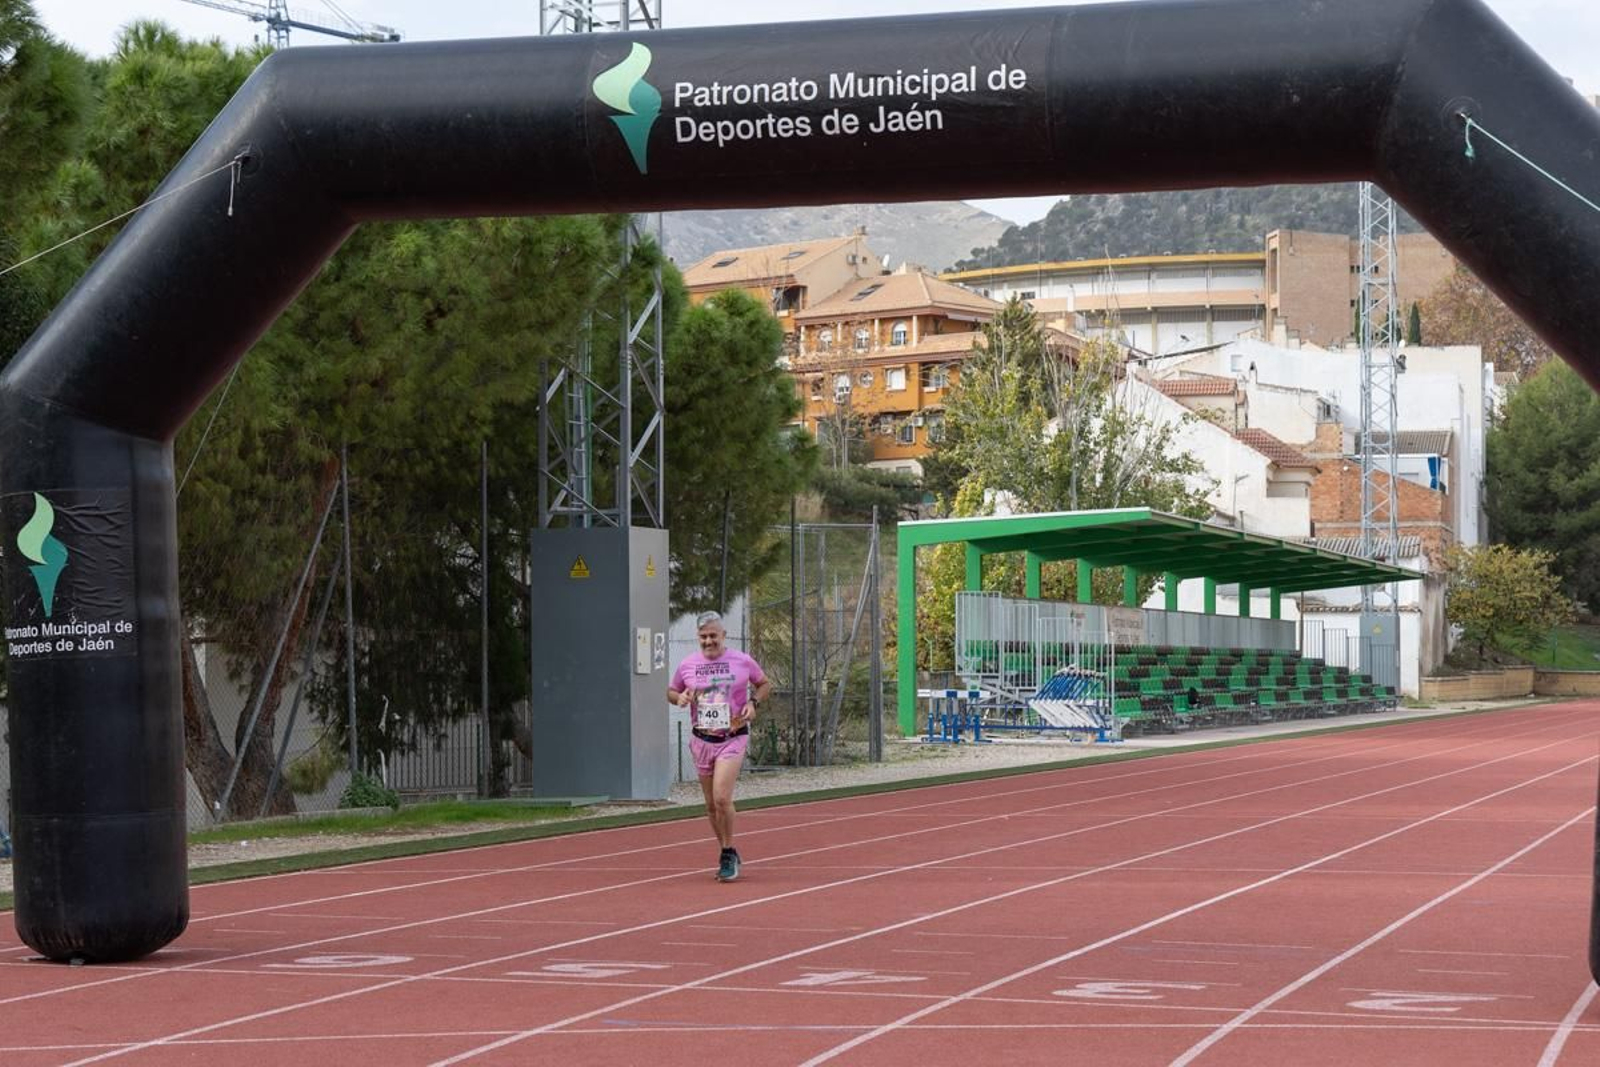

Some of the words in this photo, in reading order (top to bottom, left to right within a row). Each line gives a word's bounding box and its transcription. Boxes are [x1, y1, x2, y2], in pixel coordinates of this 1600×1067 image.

[674, 77, 818, 107] Patronato
[829, 66, 977, 100] Municipal
[987, 64, 1027, 91] de
[674, 114, 812, 147] Deportes
[820, 108, 860, 135] de
[869, 103, 943, 134] Jaén
[41, 620, 110, 637] Municipal
[114, 620, 133, 633] de
[9, 641, 53, 658] Deportes
[55, 638, 74, 652] de
[78, 637, 114, 652] Jaén
[705, 710, 719, 719] 40
